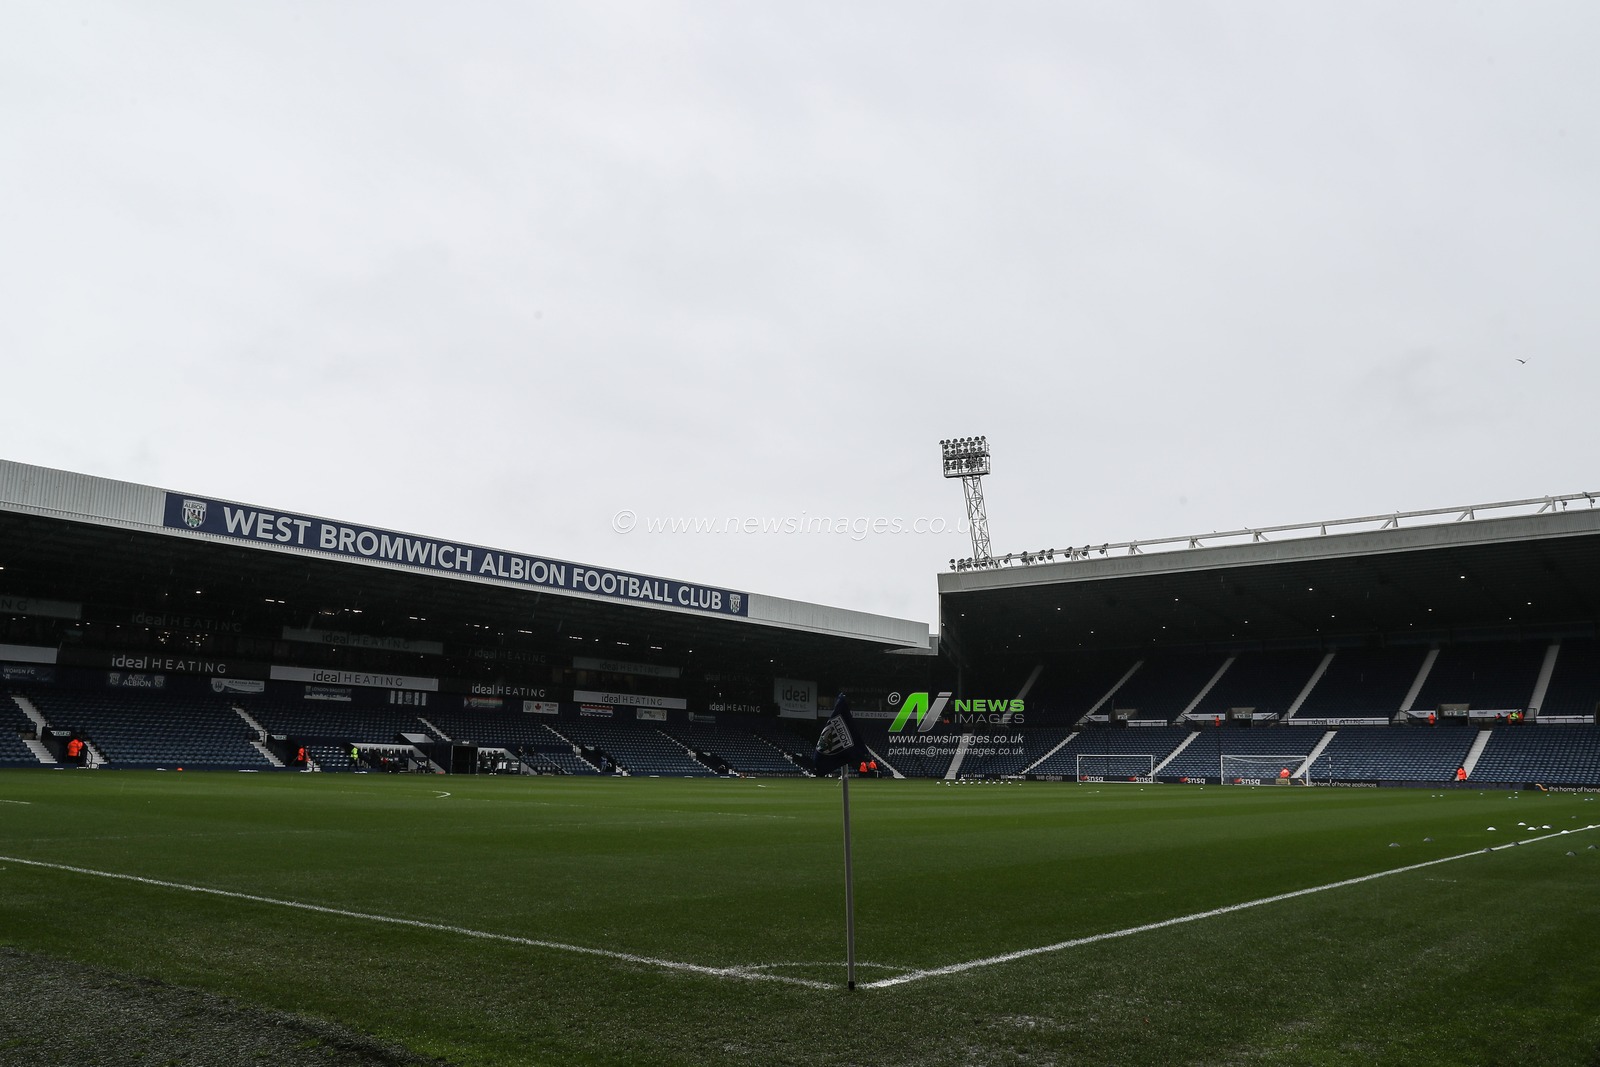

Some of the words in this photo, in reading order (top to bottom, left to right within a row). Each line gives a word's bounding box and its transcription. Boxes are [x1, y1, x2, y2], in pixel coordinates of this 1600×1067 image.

[223, 506, 312, 545] WEST
[319, 523, 473, 572] BROMWICH
[479, 552, 566, 586] ALBION
[572, 567, 673, 603] FOOTBALL
[677, 585, 723, 611] CLUB
[131, 612, 166, 627] ideal
[170, 615, 242, 633] HEATING
[322, 631, 350, 645] ideal
[352, 636, 410, 650] HEATING
[111, 654, 148, 669] ideal
[151, 657, 226, 674] HEATING
[122, 679, 152, 688] ALBION
[312, 670, 341, 683] ideal
[344, 673, 403, 687] HEATING
[471, 683, 495, 695] ideal
[497, 686, 546, 698] HEATING
[782, 685, 810, 703] ideal
[601, 694, 621, 704] ideal
[622, 696, 663, 706] HEATING
[709, 702, 726, 712] ideal
[726, 703, 761, 713] HEATING
[832, 718, 849, 748] ALBION
